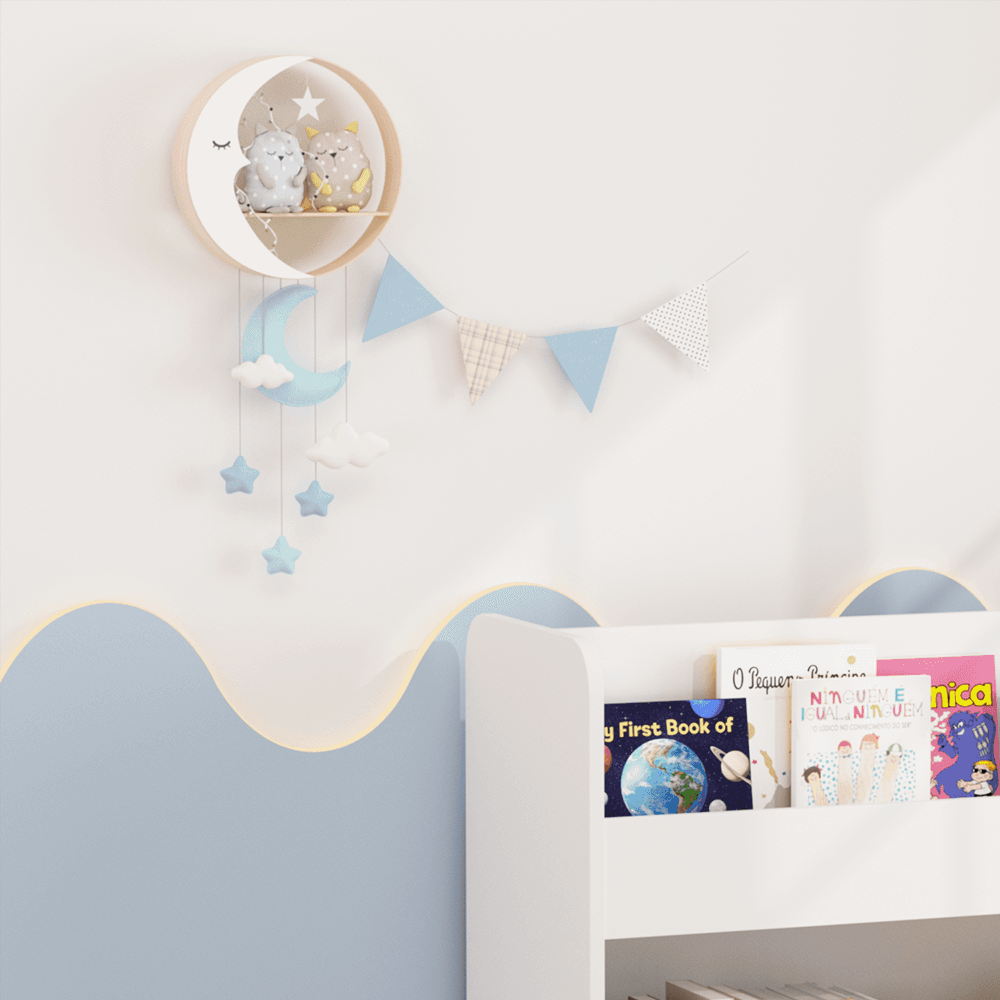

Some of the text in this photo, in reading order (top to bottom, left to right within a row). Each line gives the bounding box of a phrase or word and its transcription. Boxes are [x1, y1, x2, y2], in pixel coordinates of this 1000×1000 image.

[733, 667, 744, 690] O
[748, 666, 803, 695] Pequen
[619, 721, 662, 738] First
[666, 718, 711, 736] Book
[715, 716, 734, 733] of
